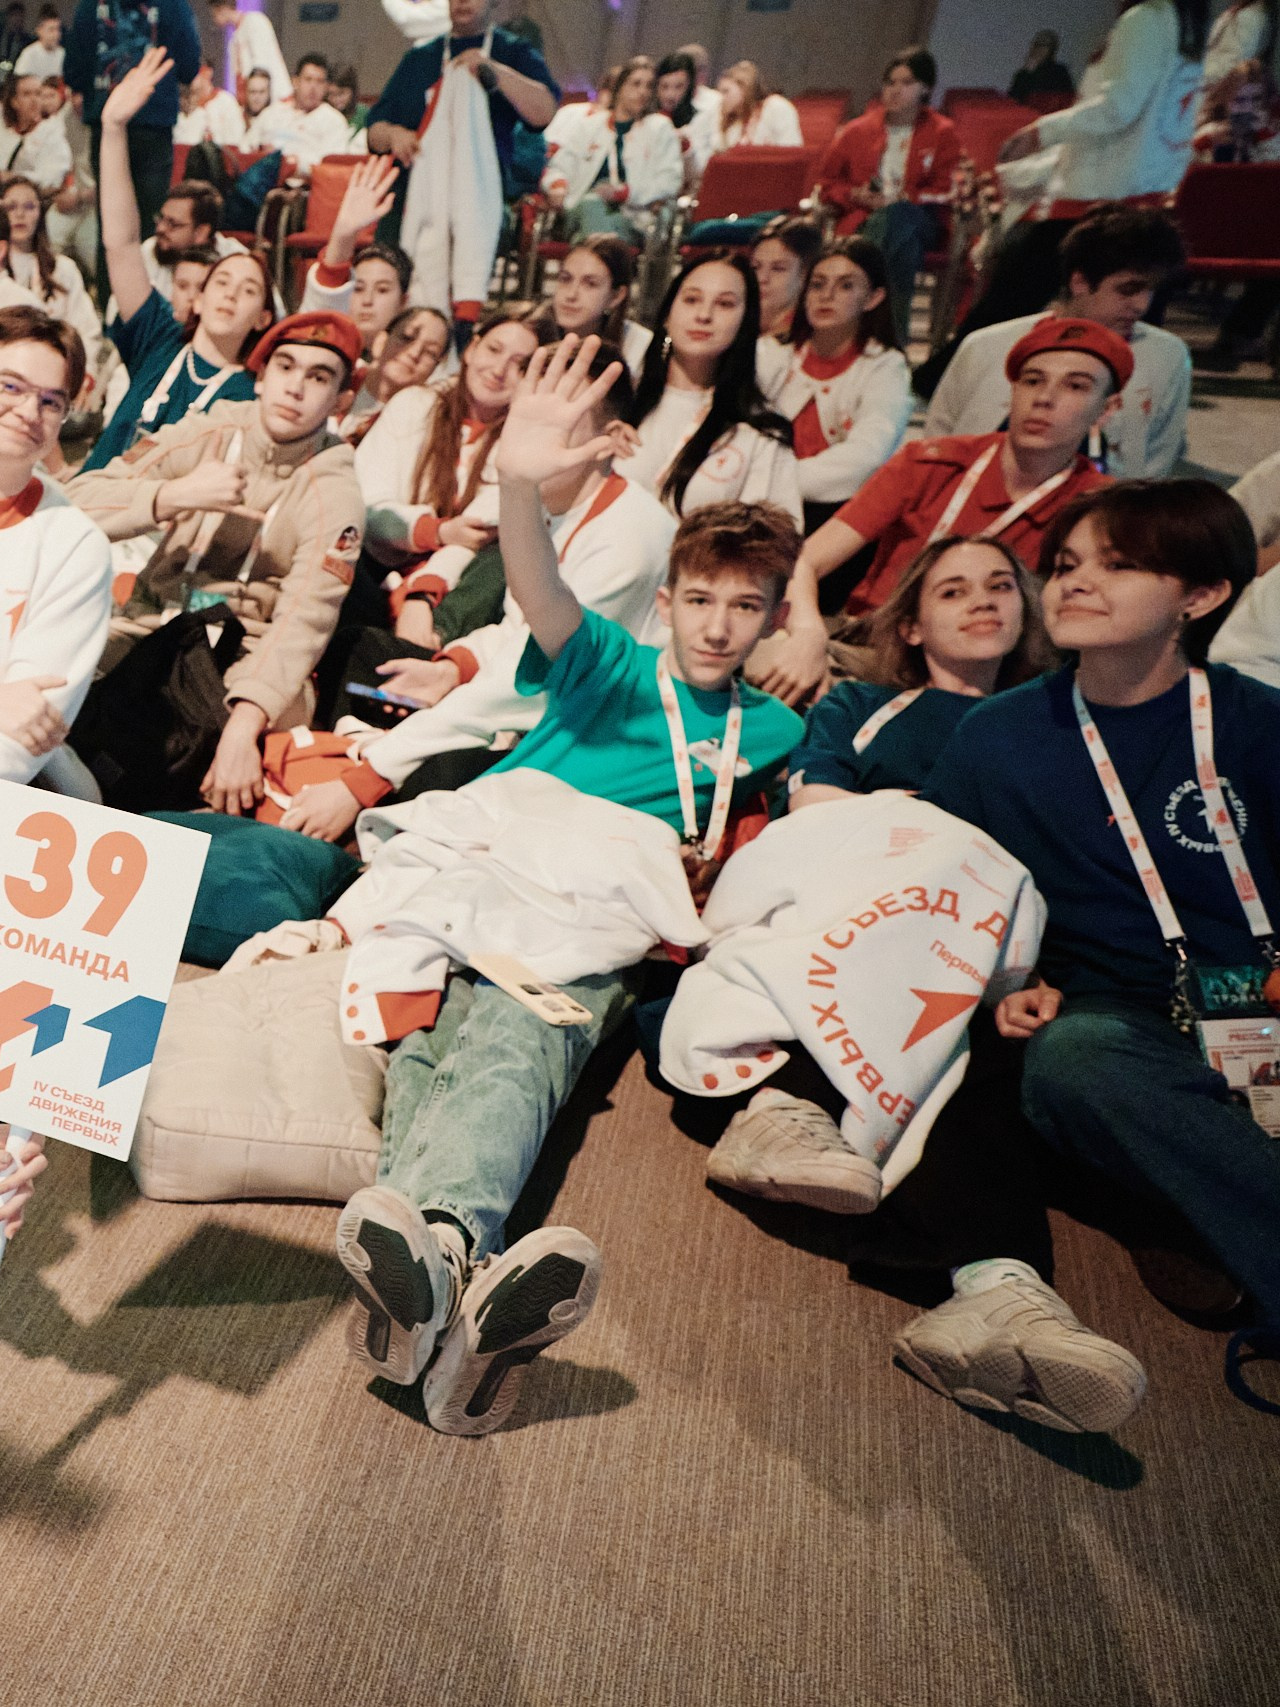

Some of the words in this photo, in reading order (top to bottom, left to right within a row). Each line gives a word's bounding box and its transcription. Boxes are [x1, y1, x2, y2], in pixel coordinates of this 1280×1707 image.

[3, 811, 148, 937] 39
[807, 952, 838, 990] IV
[823, 885, 961, 951] СЪЕЗД
[930, 939, 988, 988] Первы
[810, 1000, 917, 1126] ЕРВЫХ
[28, 1095, 122, 1134] ДВИЖЕНИЯ
[33, 1079, 48, 1094] IV
[50, 1083, 105, 1113] СЪЕЗД
[51, 1116, 119, 1147] ПЕРВЫХ
